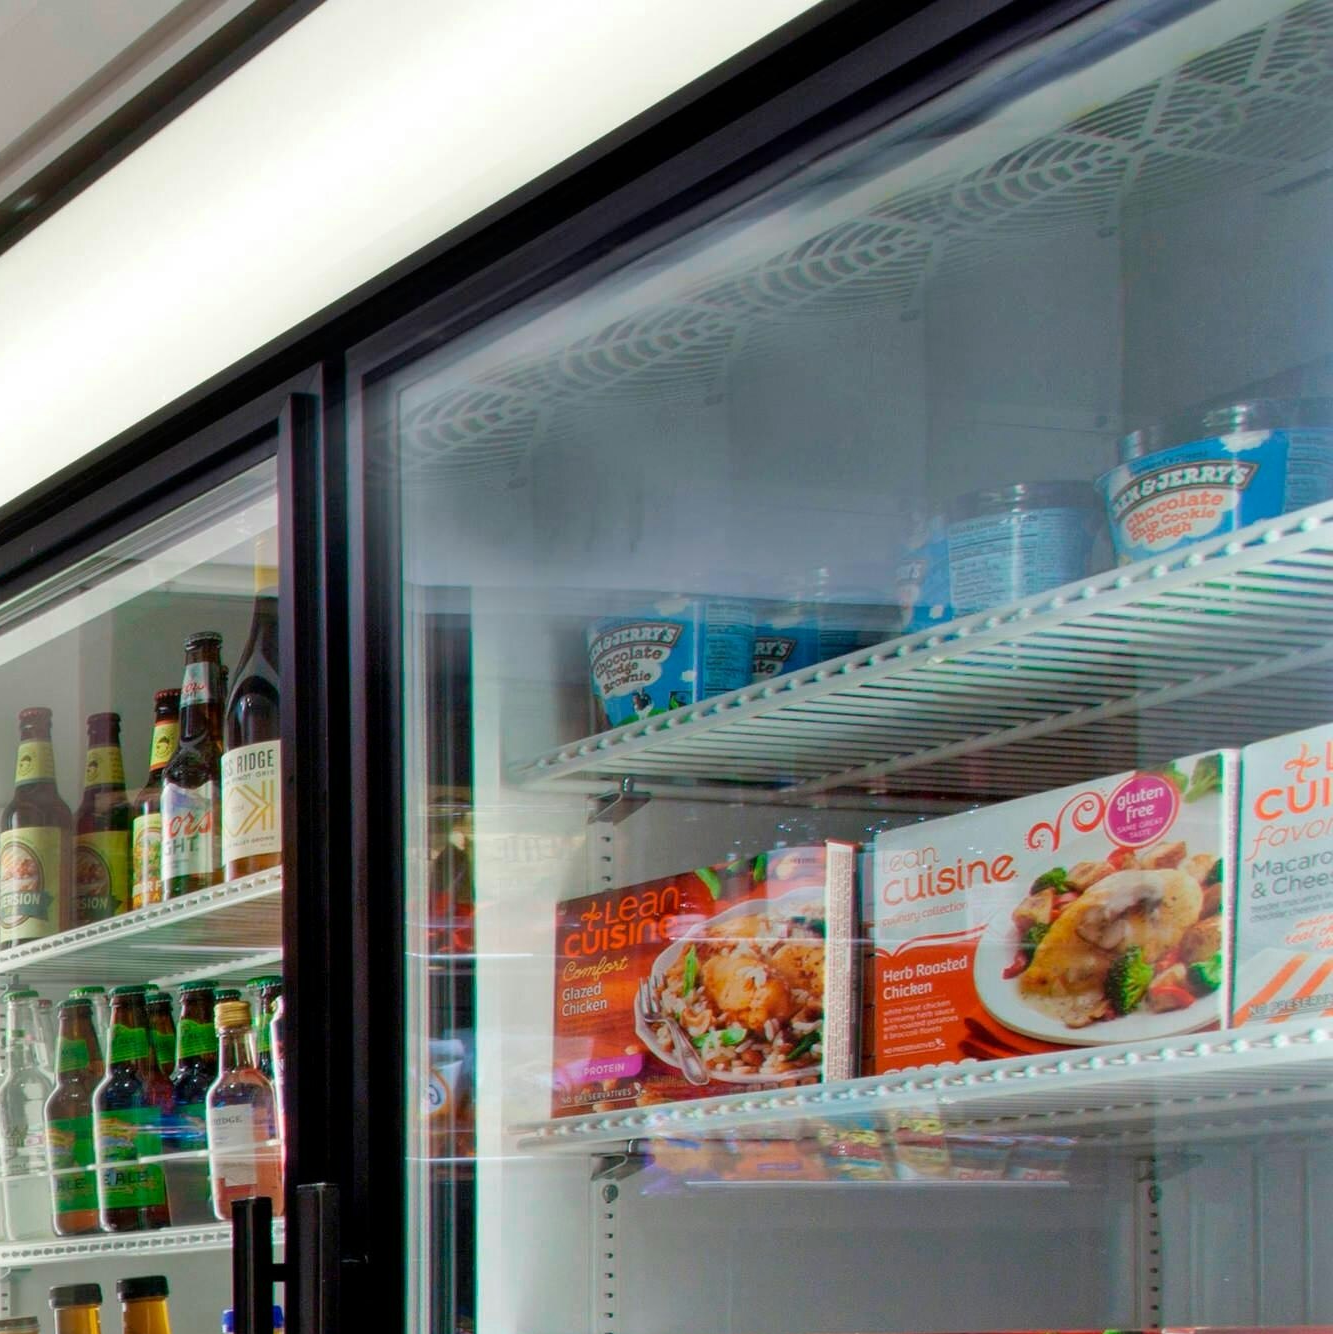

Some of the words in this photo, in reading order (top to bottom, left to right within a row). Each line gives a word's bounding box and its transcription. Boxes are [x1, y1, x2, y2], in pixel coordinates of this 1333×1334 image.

[1157, 464, 1249, 492] JERRY'S
[1126, 492, 1223, 532] Chocolate
[236, 749, 274, 771] RIDGE
[1117, 787, 1164, 811] gluten
[1126, 804, 1154, 823] free
[882, 854, 1017, 906] cuisine
[605, 886, 679, 924] Lean
[563, 957, 628, 983] Comfort
[883, 966, 913, 983] Herb
[917, 956, 967, 977] Roasted
[562, 982, 602, 1002] Glazed
[883, 982, 932, 1000] Chicken
[562, 999, 607, 1017] Chicken
[584, 1062, 625, 1077] PROTEIN
